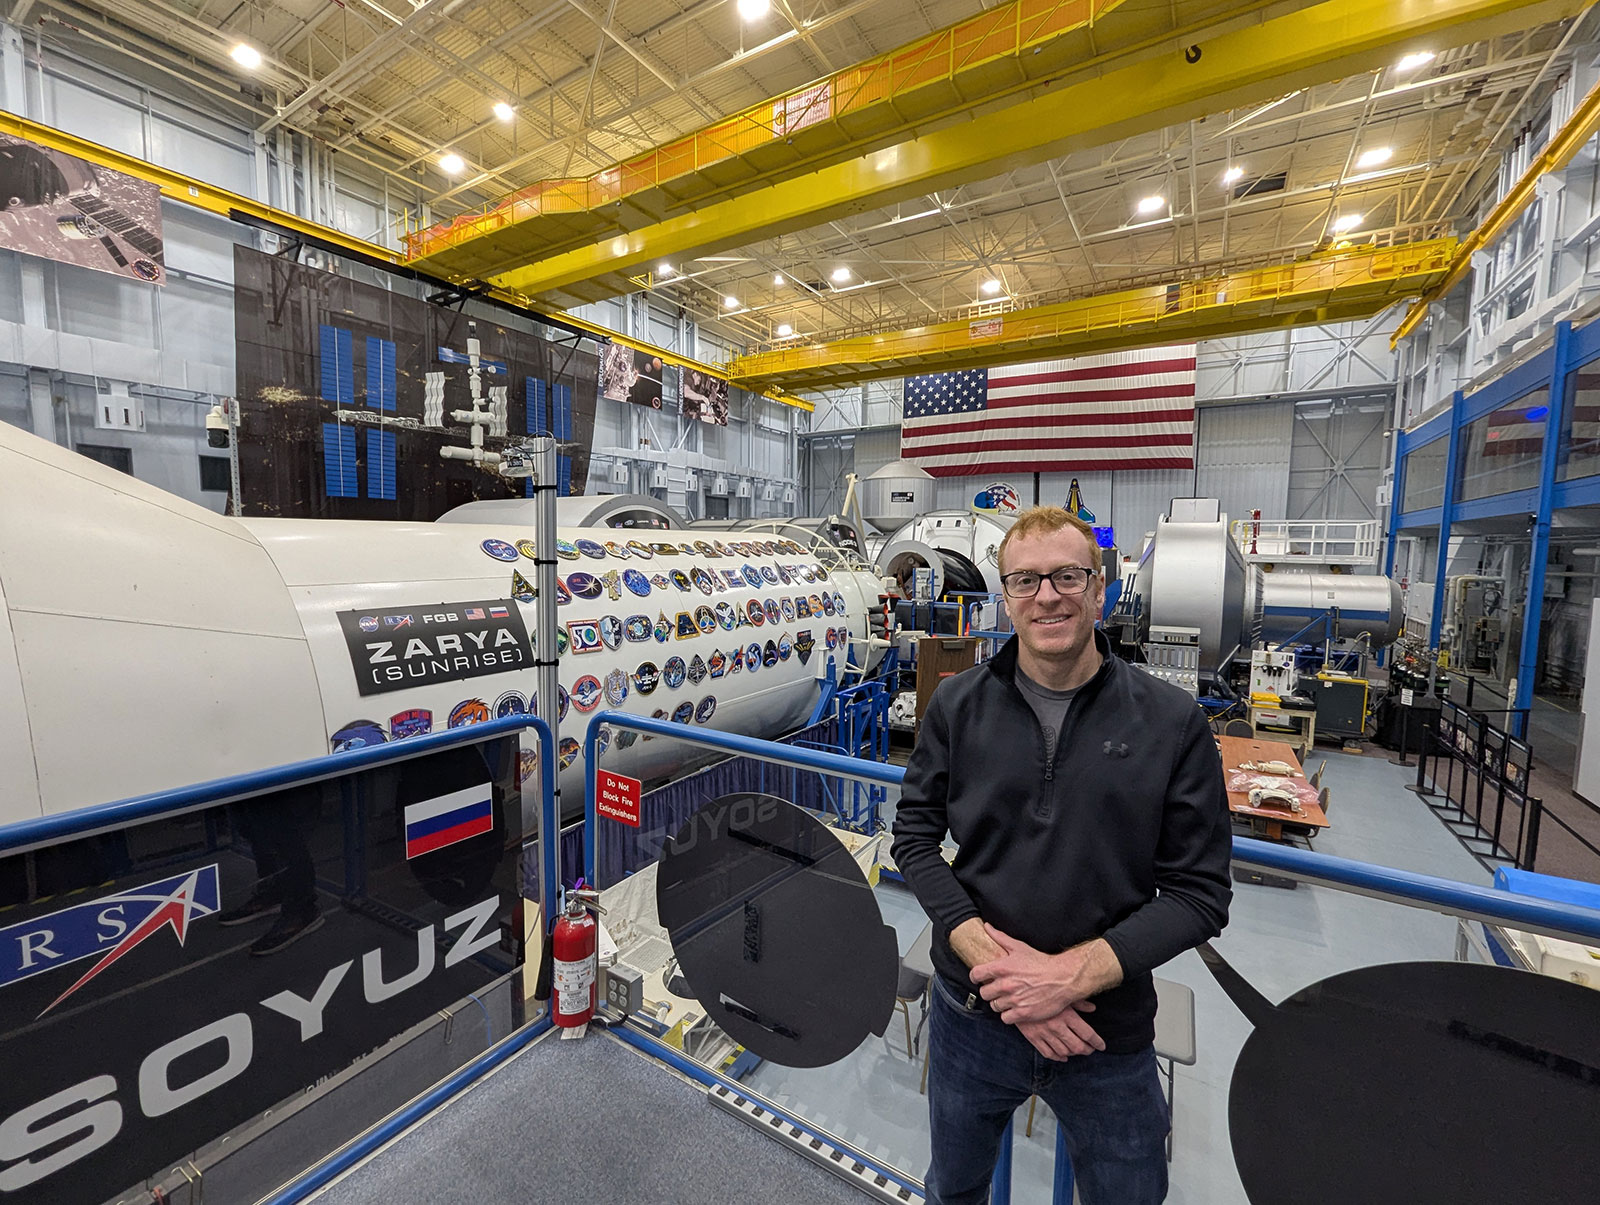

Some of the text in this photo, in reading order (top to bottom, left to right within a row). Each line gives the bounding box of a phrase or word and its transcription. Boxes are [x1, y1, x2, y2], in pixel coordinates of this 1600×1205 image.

[422, 613, 459, 625] FGB
[365, 628, 519, 664] ZARYA
[372, 648, 523, 684] (SUNRISE)
[607, 778, 630, 792] Do Not
[603, 790, 633, 807] Block Fire
[599, 802, 637, 822] Extinguishers
[0, 894, 502, 1192] SOYUZ
